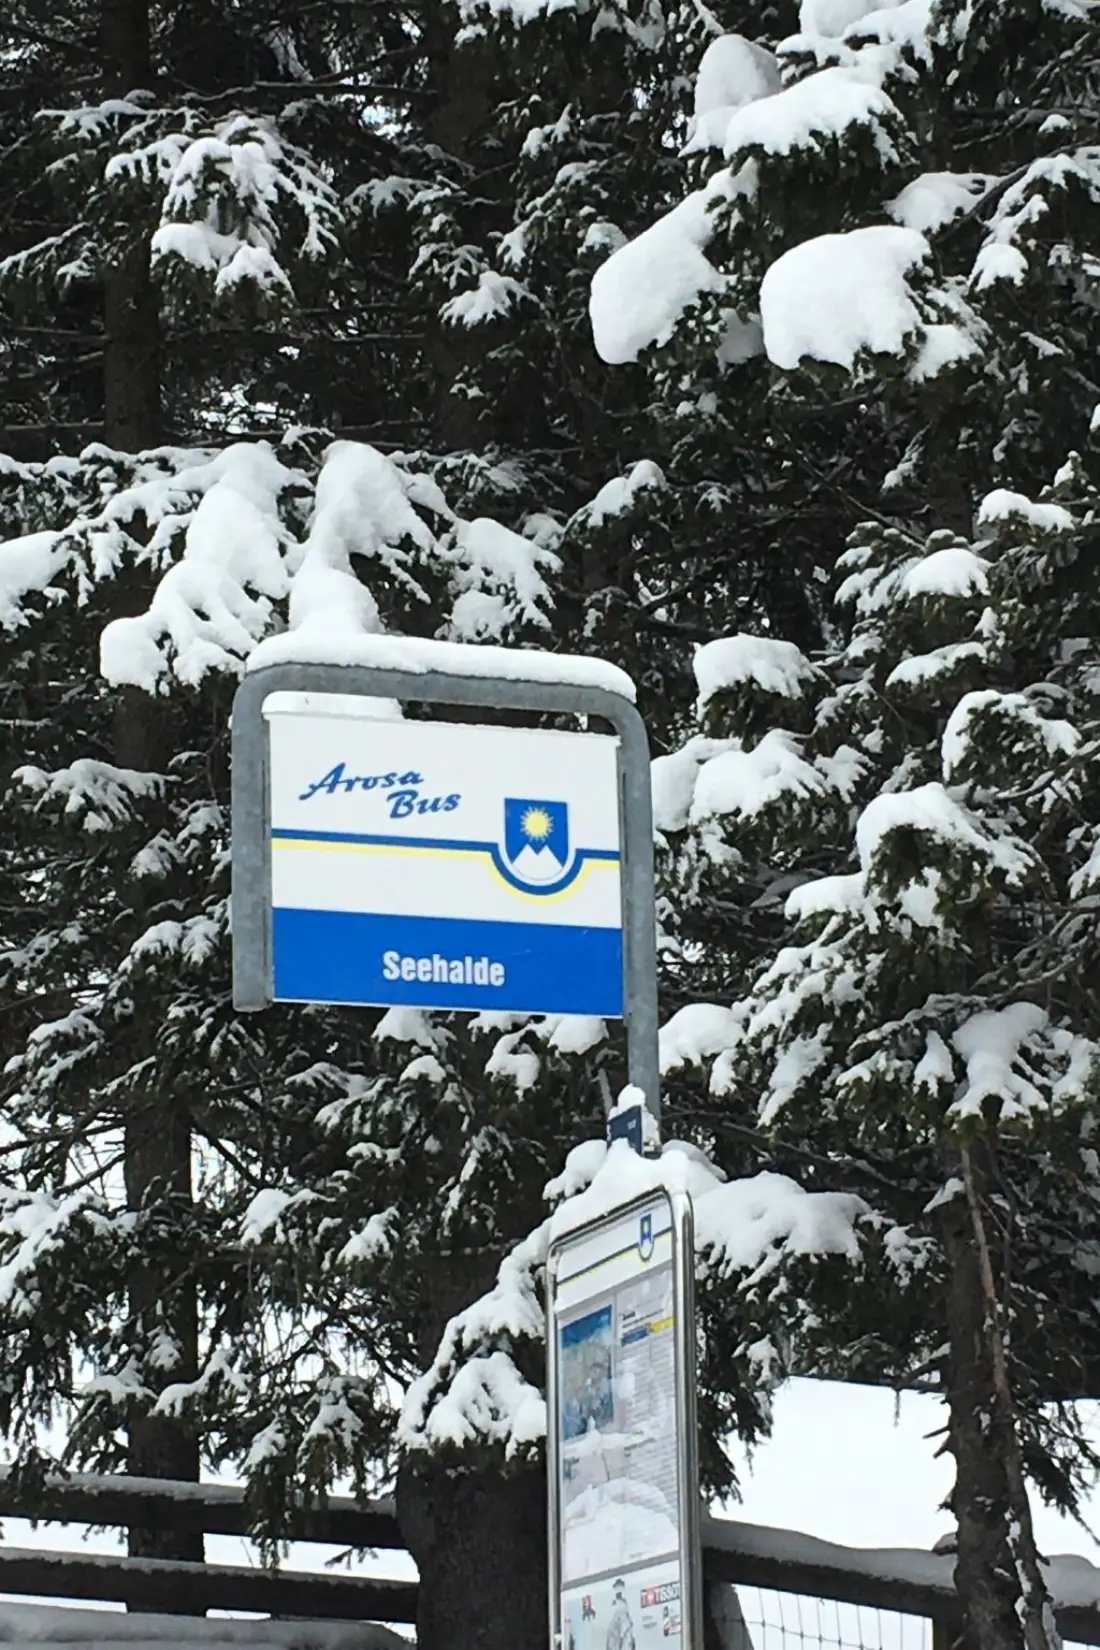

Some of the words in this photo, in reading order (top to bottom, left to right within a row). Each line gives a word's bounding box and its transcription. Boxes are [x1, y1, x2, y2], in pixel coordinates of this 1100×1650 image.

[299, 762, 424, 801] Arosa
[386, 789, 461, 819] Bus
[382, 950, 505, 987] Seehalde
